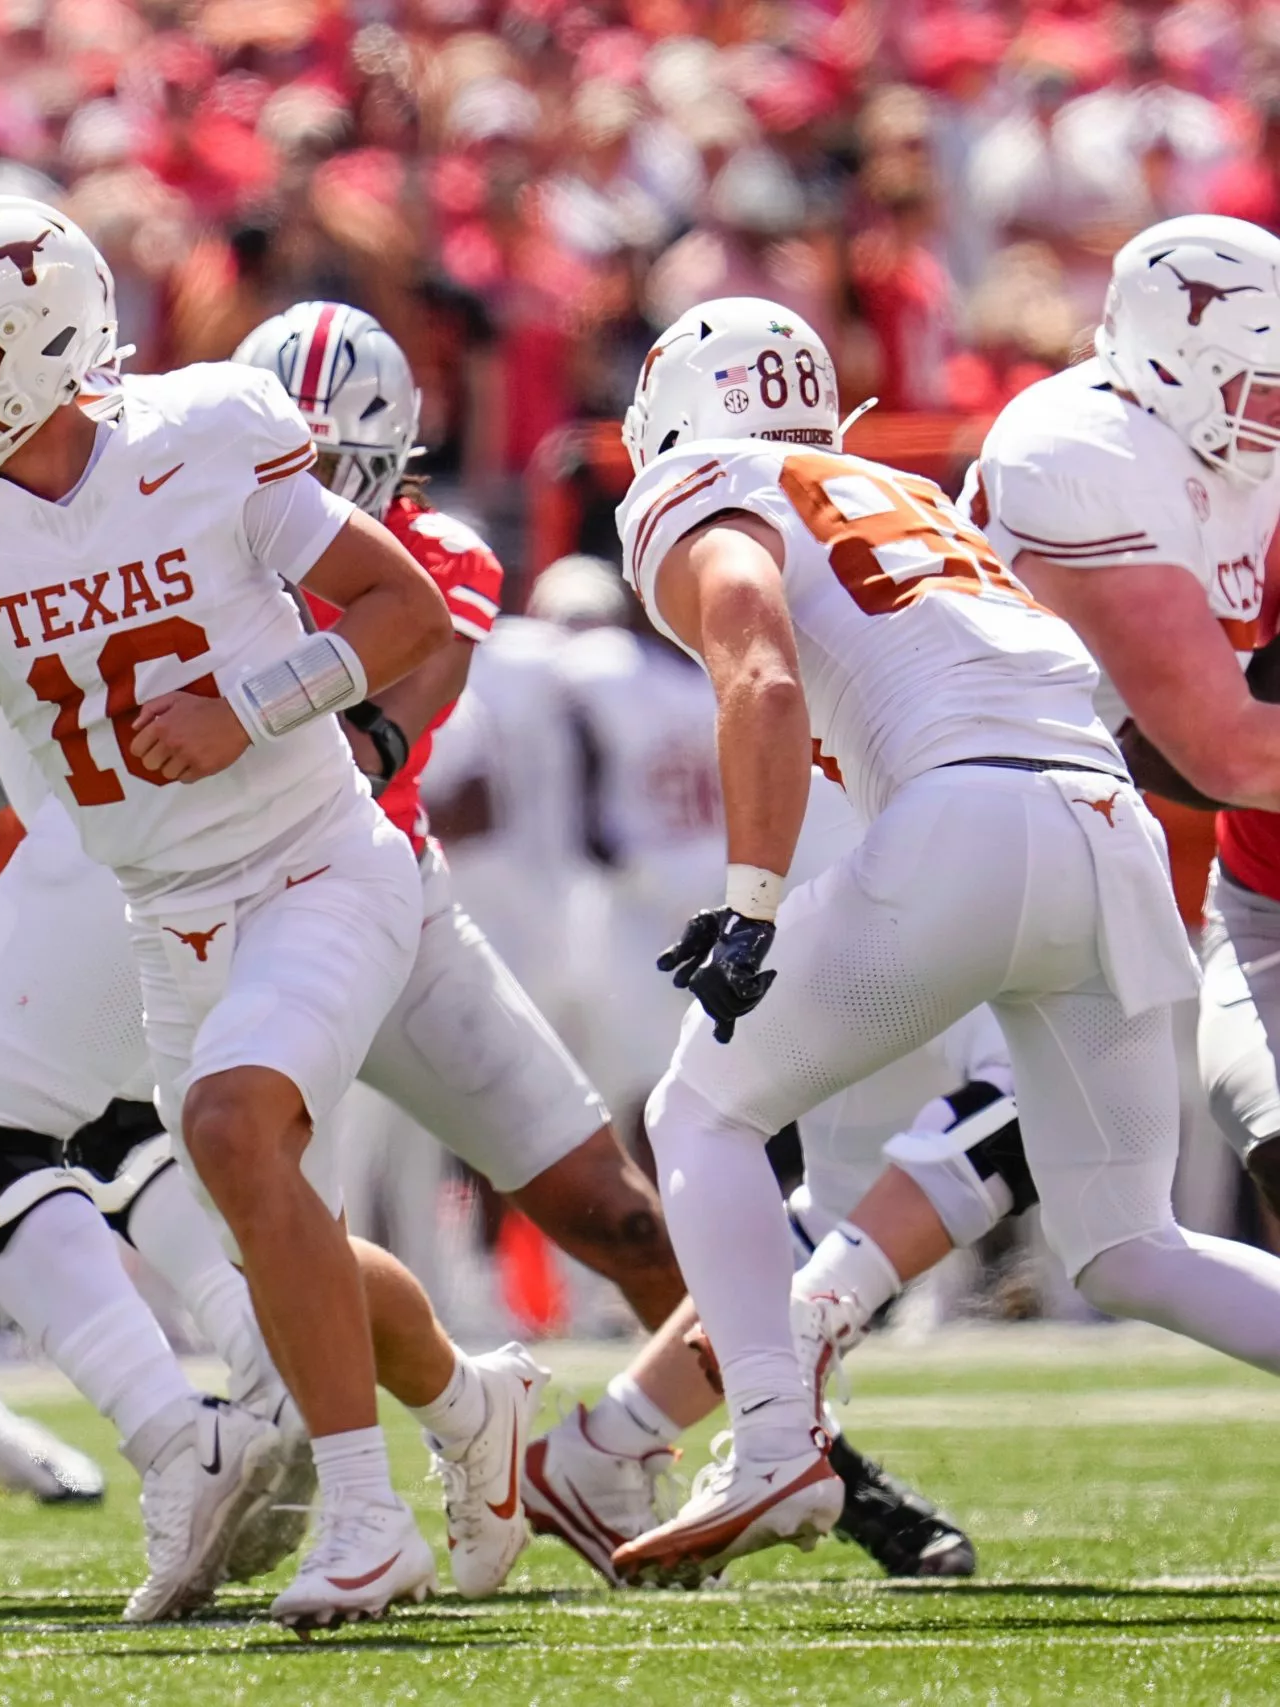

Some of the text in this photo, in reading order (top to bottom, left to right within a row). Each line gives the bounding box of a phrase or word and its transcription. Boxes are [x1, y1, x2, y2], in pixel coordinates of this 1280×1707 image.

[757, 349, 820, 409] 88
[724, 388, 749, 414] SEC
[750, 428, 833, 446] ONGHORNS
[26, 615, 222, 807] 16
